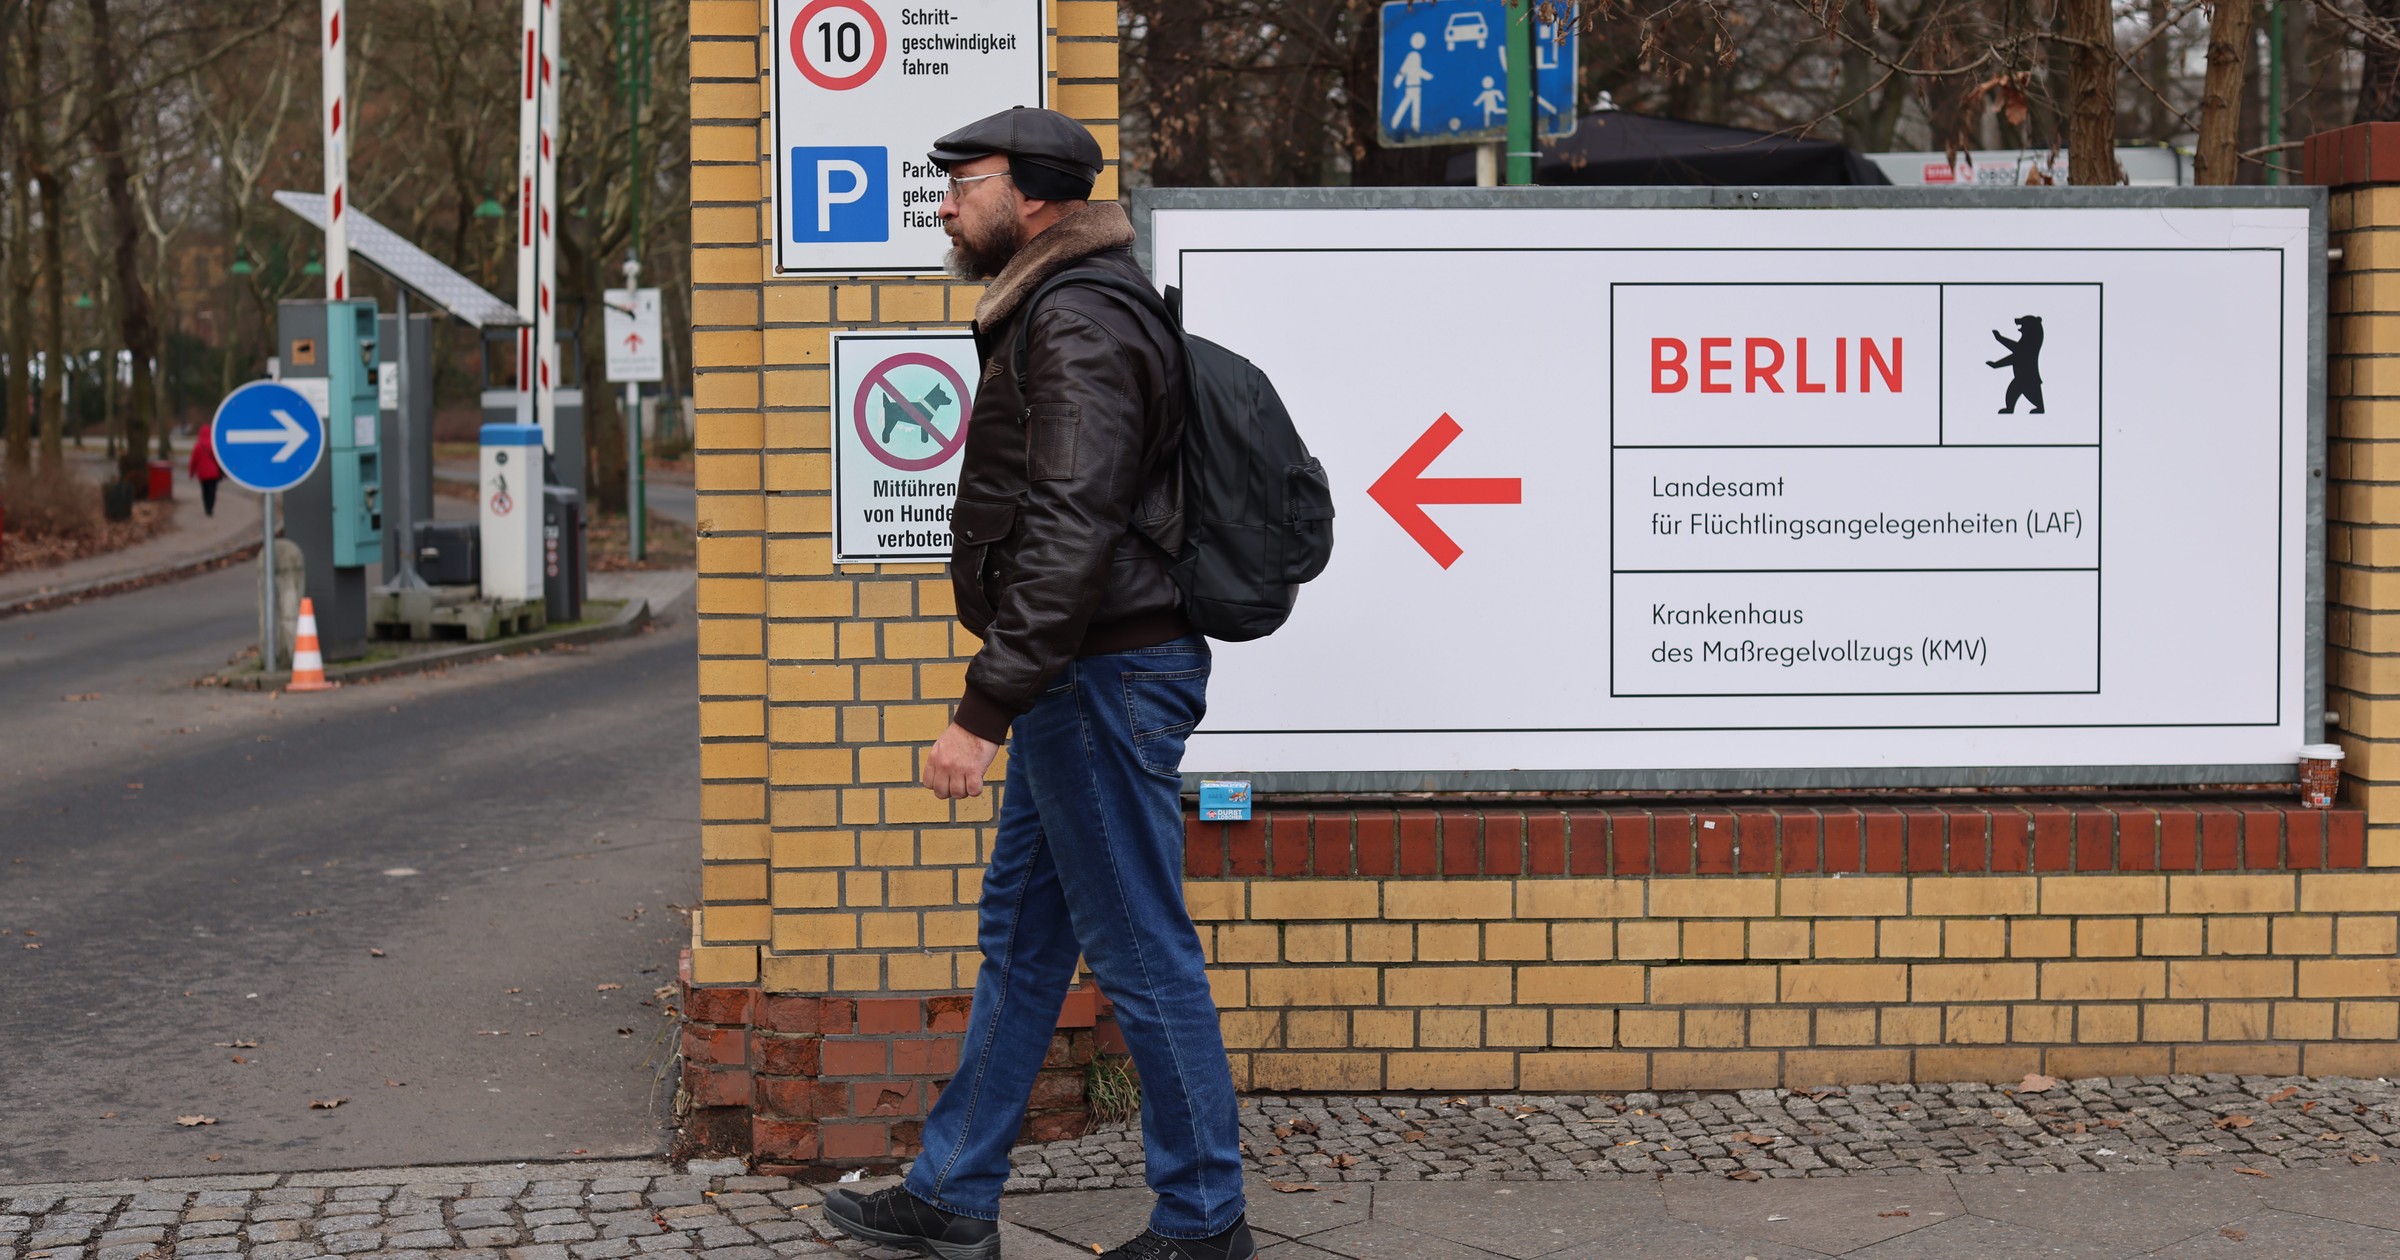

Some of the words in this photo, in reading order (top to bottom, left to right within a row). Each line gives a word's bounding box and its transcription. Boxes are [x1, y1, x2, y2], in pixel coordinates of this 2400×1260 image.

[902, 9, 958, 25] Schritt-
[818, 22, 861, 63] 10
[902, 33, 1016, 54] geschwindigkeit
[902, 59, 949, 76] fahren
[817, 159, 868, 232] P
[903, 186, 948, 207] geken
[903, 211, 945, 227] Fläch
[1651, 337, 1903, 393] BERLIN
[873, 479, 956, 498] Mitführen
[1653, 475, 1784, 497] Landesamt
[863, 508, 894, 523] von
[1652, 512, 1682, 535] für
[1691, 511, 2017, 540] Flüchtlingsangelegenheiten
[2026, 509, 2083, 538] (LAF)
[877, 530, 952, 547] verboten
[1653, 603, 1804, 625] Krankenhaus
[1651, 641, 1693, 662] des
[1703, 639, 1913, 667] Maßregelvollzugs
[1922, 637, 1987, 666] (KMV)
